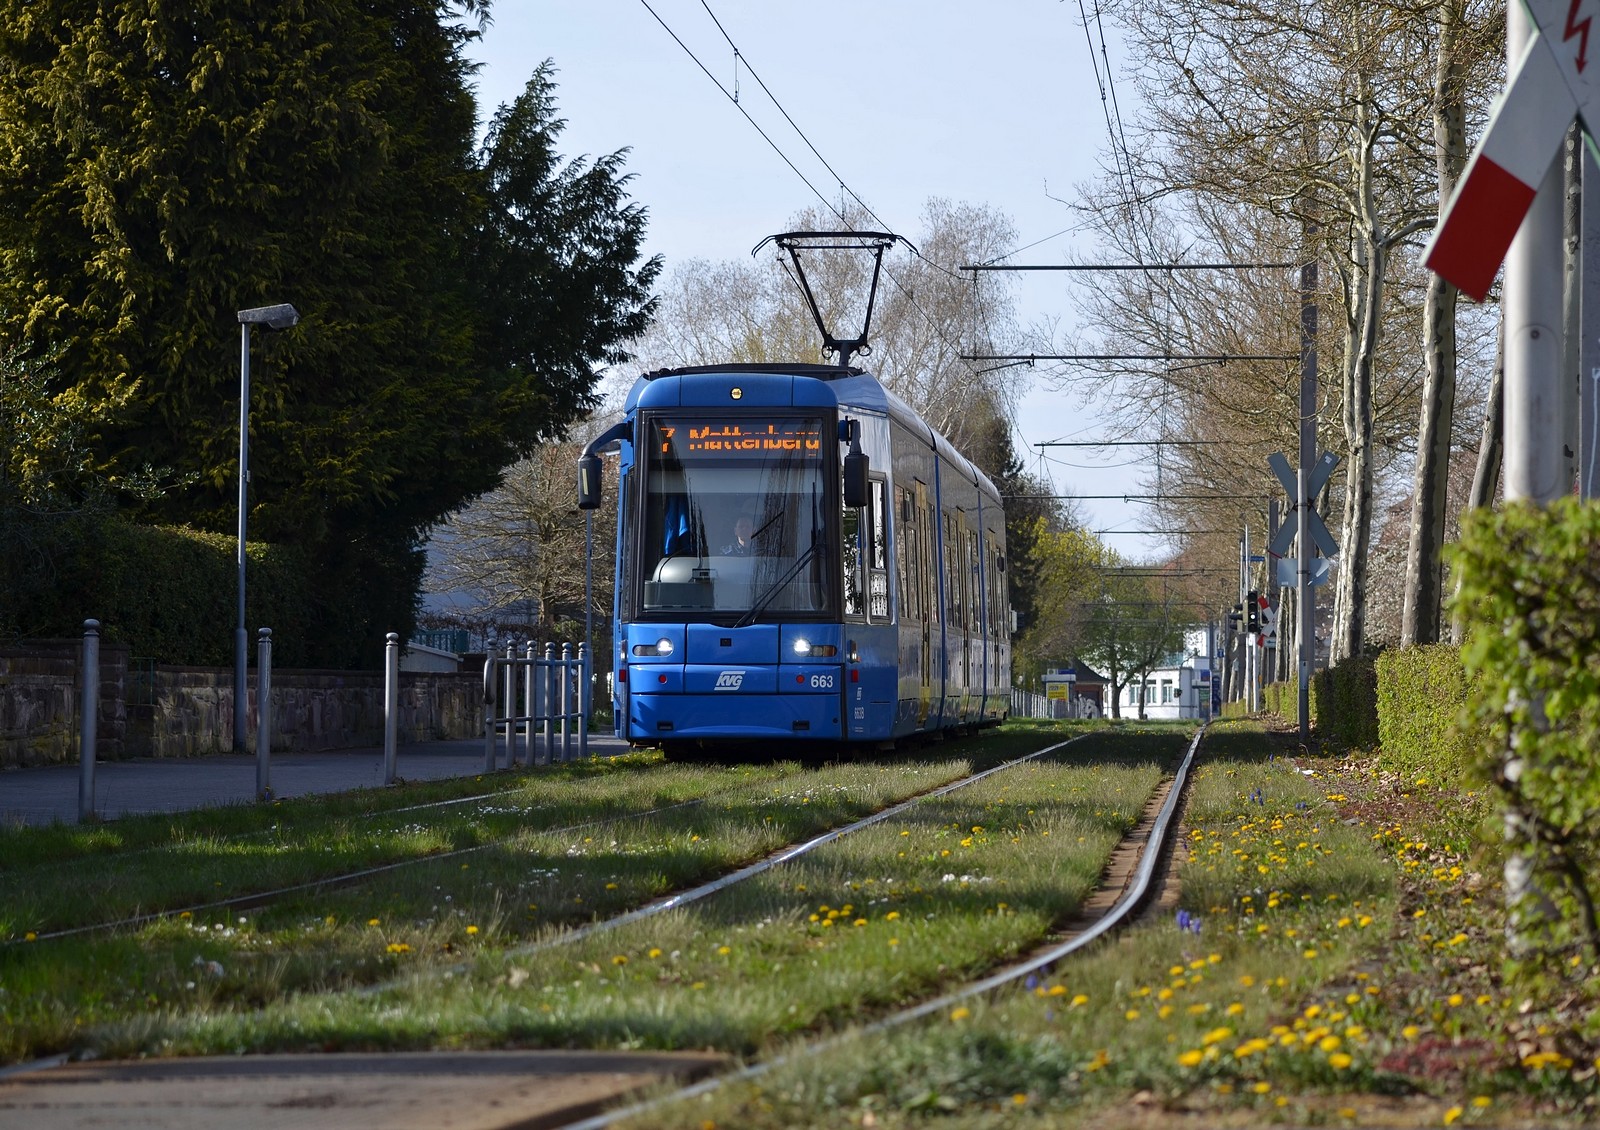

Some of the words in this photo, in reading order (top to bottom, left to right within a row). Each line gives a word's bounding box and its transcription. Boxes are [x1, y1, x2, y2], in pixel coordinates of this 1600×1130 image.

[660, 427, 676, 453] 7
[715, 673, 744, 689] KVG
[810, 675, 834, 688] 663
